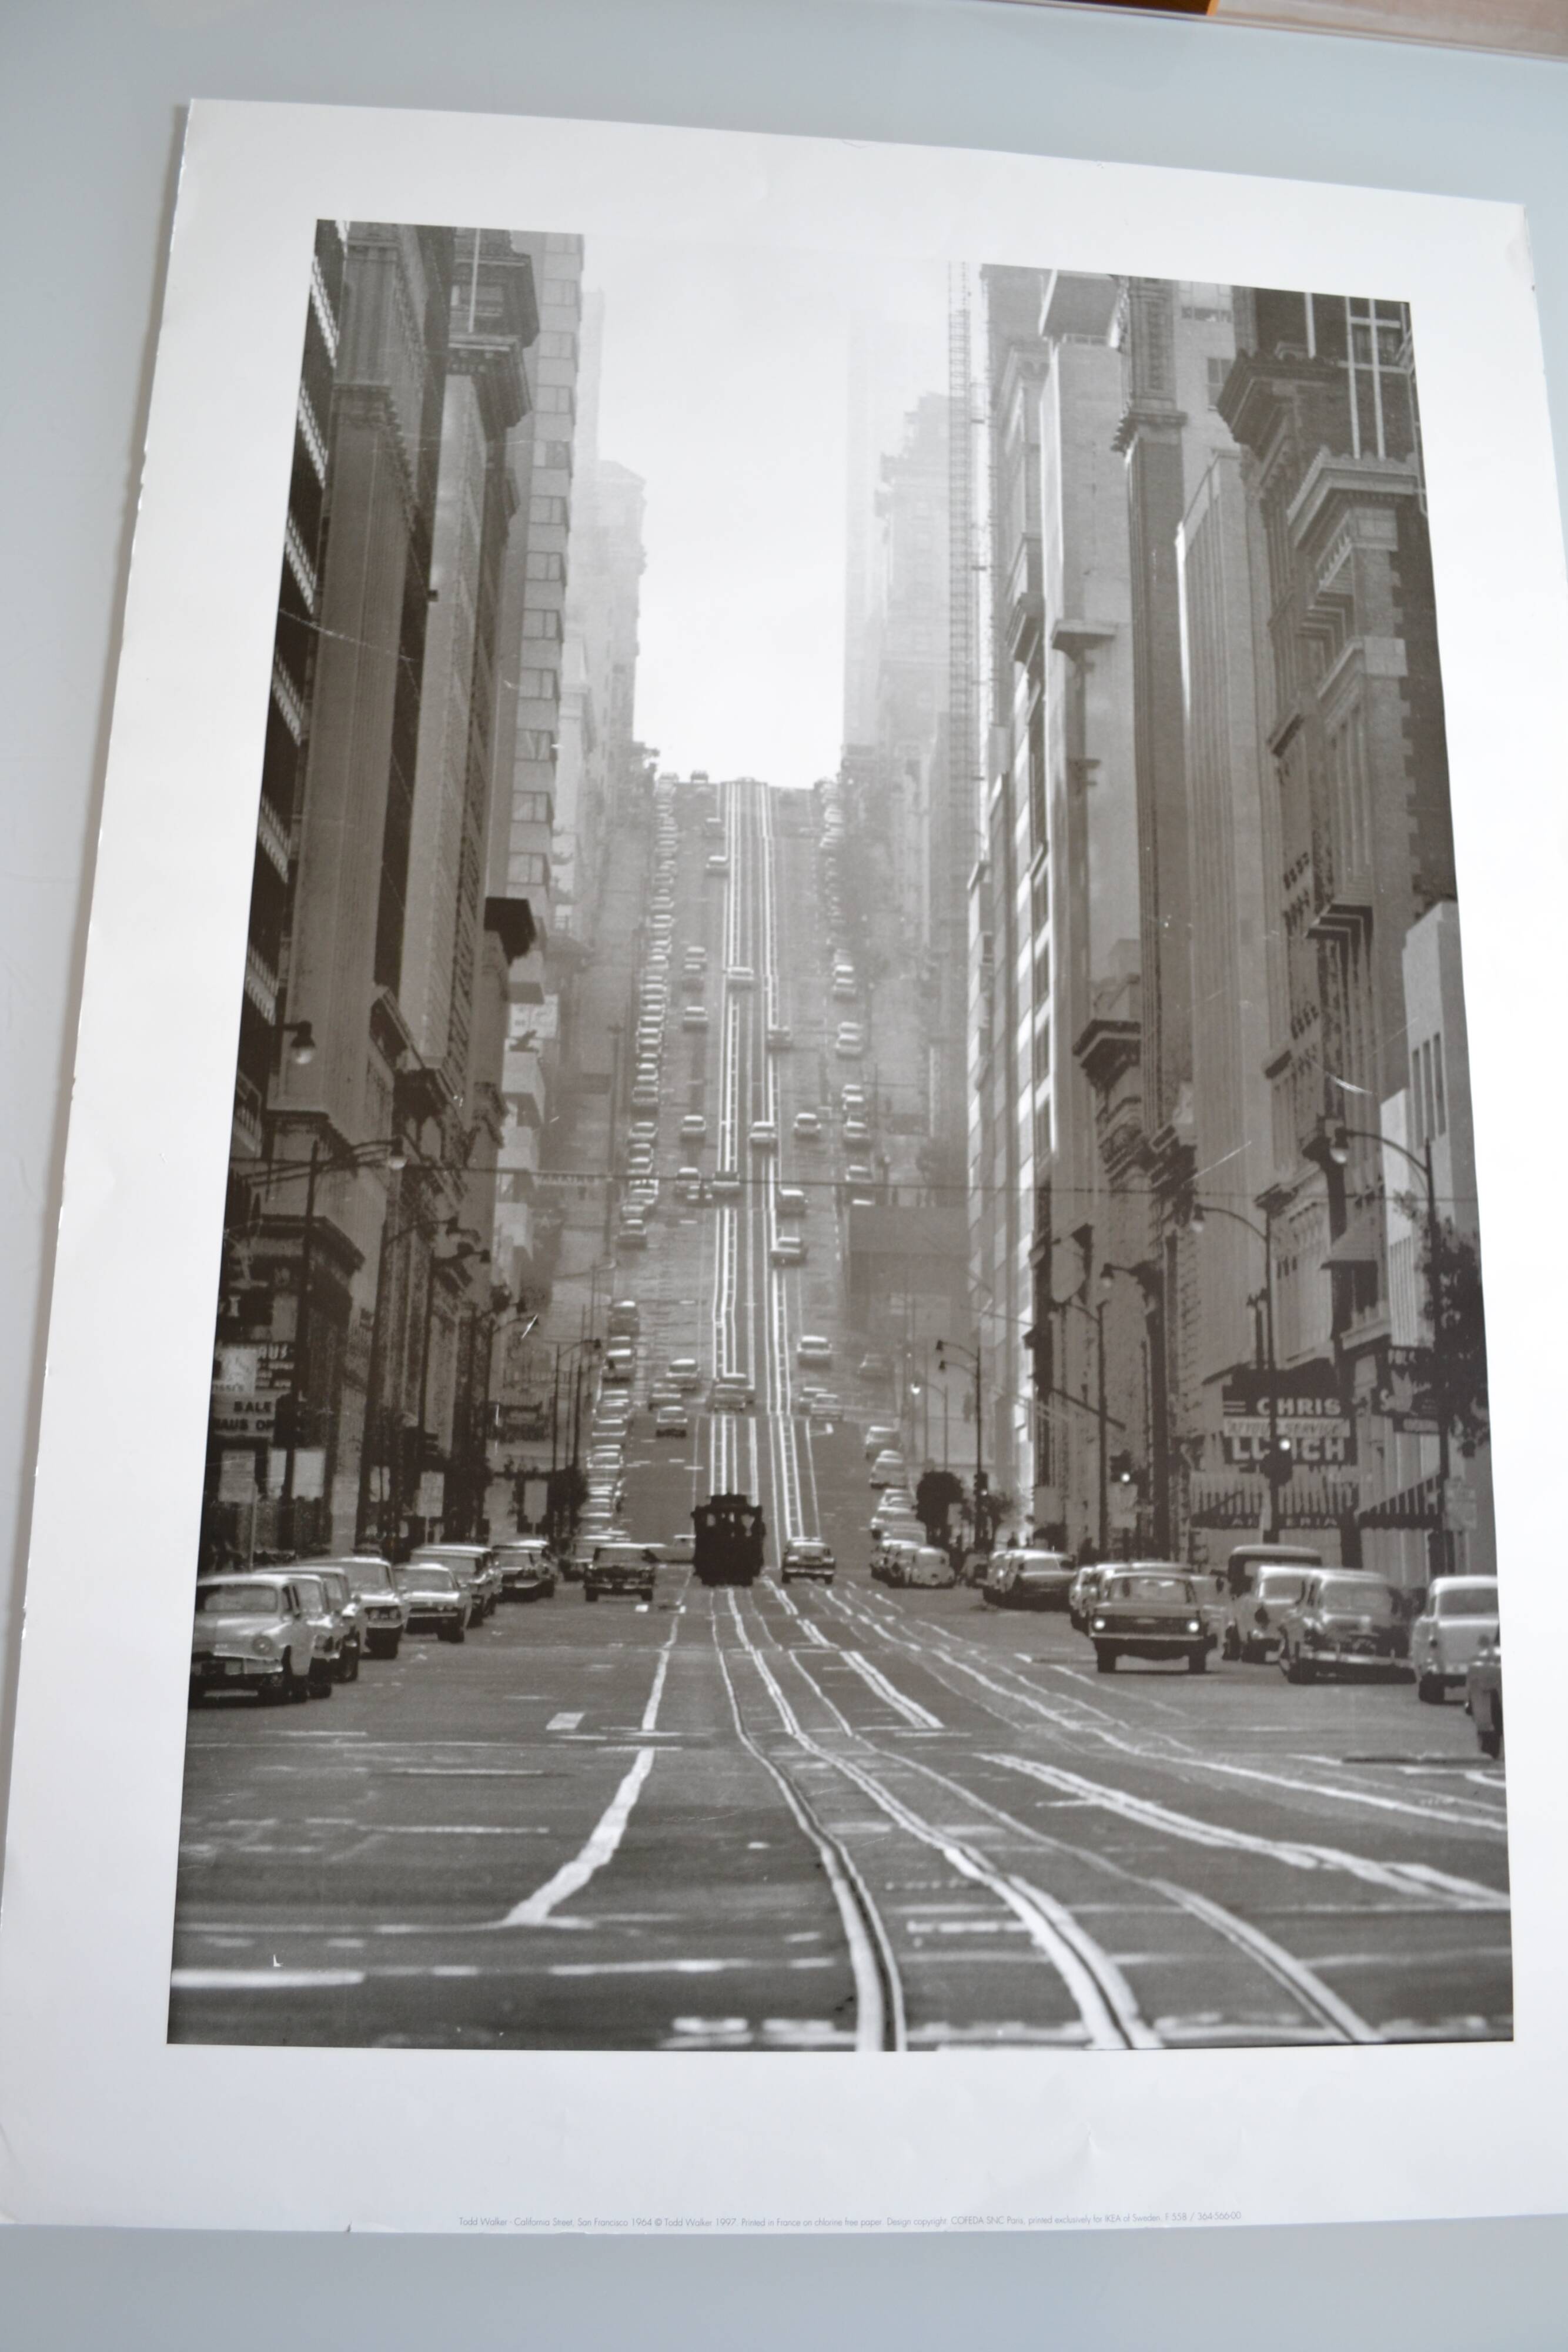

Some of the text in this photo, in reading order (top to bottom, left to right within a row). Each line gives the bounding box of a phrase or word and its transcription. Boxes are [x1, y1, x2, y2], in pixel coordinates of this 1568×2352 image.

[1256, 1396, 1341, 1416] CHRIS
[1232, 1436, 1345, 1461] LUCH
[459, 2217, 477, 2226] Todd
[480, 2217, 507, 2226] Walker
[514, 2217, 549, 2226] California
[577, 2217, 591, 2226] San
[594, 2217, 628, 2226] Francisco
[633, 2217, 651, 2226] 1964
[664, 2217, 683, 2226] Todd
[686, 2218, 712, 2226] Walker
[741, 2218, 765, 2226] Printed
[768, 2218, 774, 2226] in
[777, 2218, 800, 2226] France
[814, 2217, 842, 2226] chlorine
[845, 2217, 858, 2226] free
[887, 2217, 911, 2229] Design
[951, 2216, 984, 2224] COFEDA
[987, 2216, 1004, 2224] SNC
[1028, 2216, 1052, 2226] printed
[1055, 2214, 1091, 2225] exclusively
[1094, 2214, 1102, 2223] for
[1105, 2214, 1121, 2222] IKEA
[1124, 2213, 1130, 2222] of
[1172, 2212, 1187, 2220] 558
